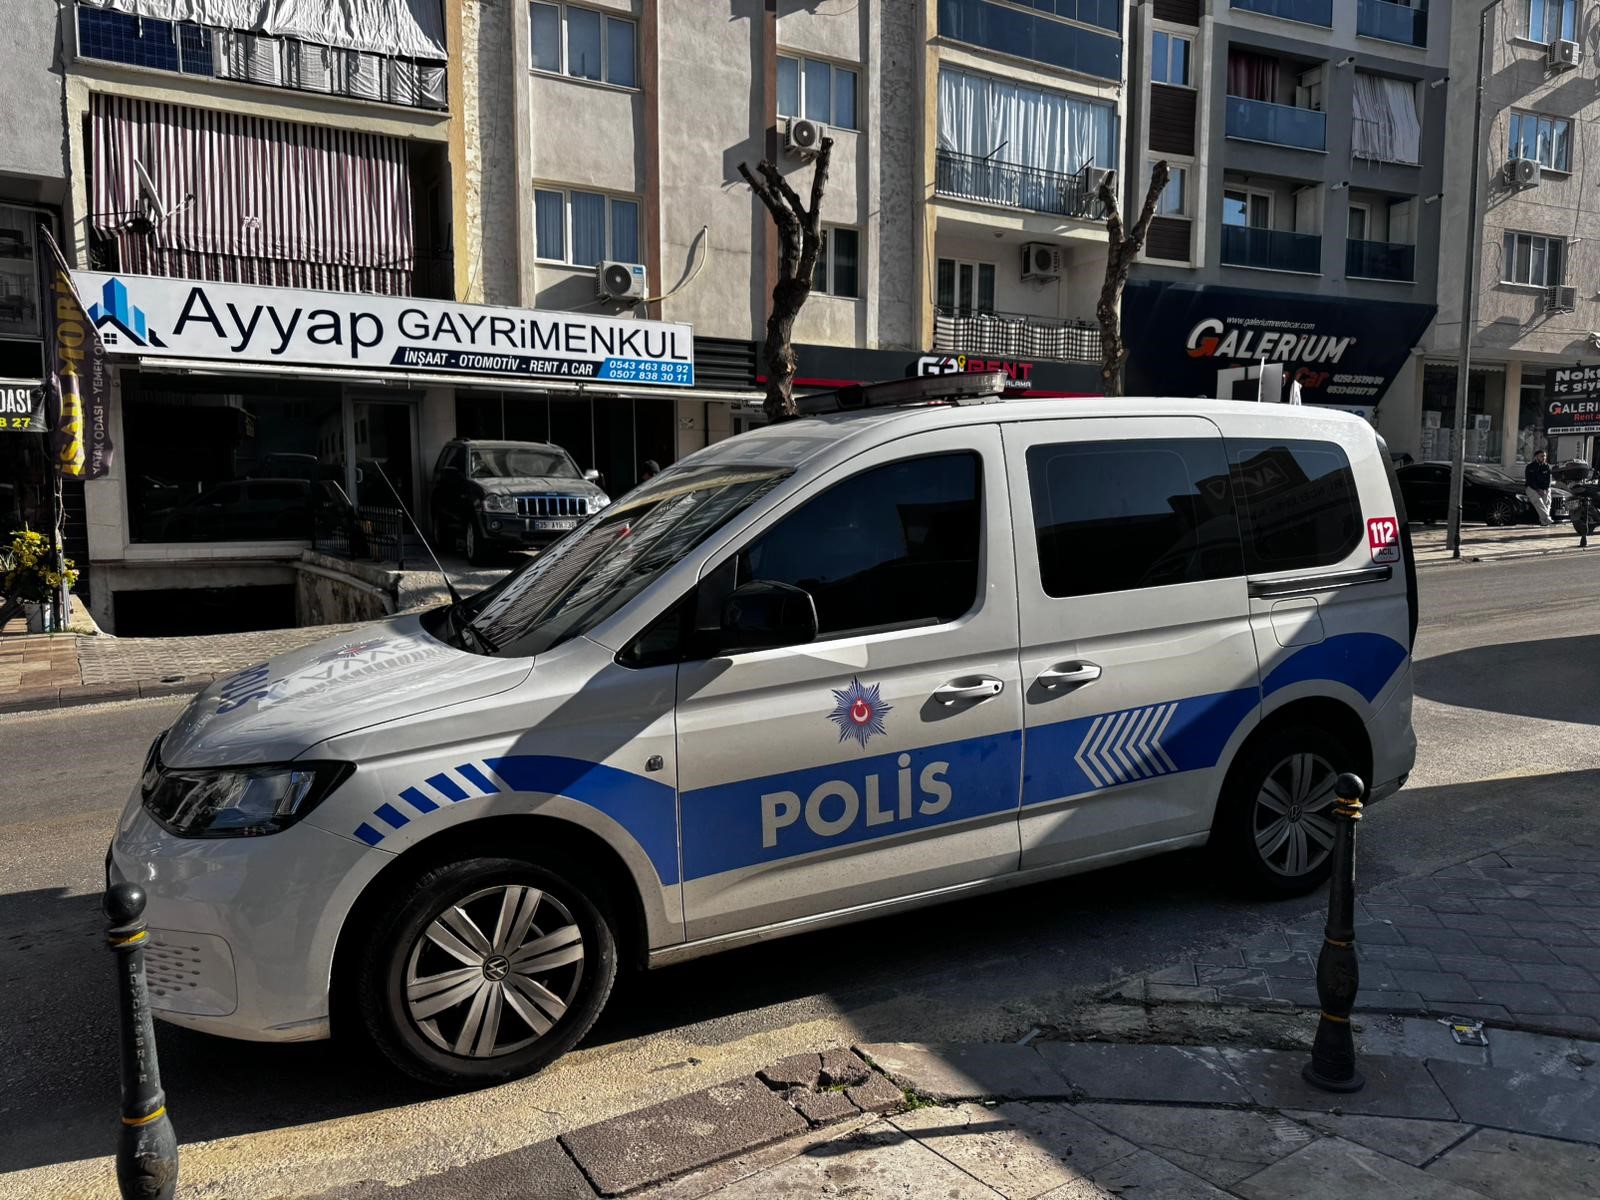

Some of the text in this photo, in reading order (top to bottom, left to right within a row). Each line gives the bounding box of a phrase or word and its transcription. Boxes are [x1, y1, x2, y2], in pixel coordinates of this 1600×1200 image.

[172, 287, 384, 358] Ayyap
[93, 359, 104, 394] YEMEK
[404, 348, 448, 368] İNŞAAT
[459, 355, 519, 371] OTOMOTİV
[529, 361, 559, 375] RENT
[561, 362, 568, 374] A
[571, 363, 593, 376] CAR
[609, 361, 689, 373] 0543 463 80 92
[609, 370, 688, 382] 0507 838 30 11
[12, 417, 31, 428] 27
[94, 406, 104, 439] ODASI
[93, 440, 104, 475] YATAK
[1371, 521, 1396, 544] 112
[760, 753, 952, 848] POLİS
